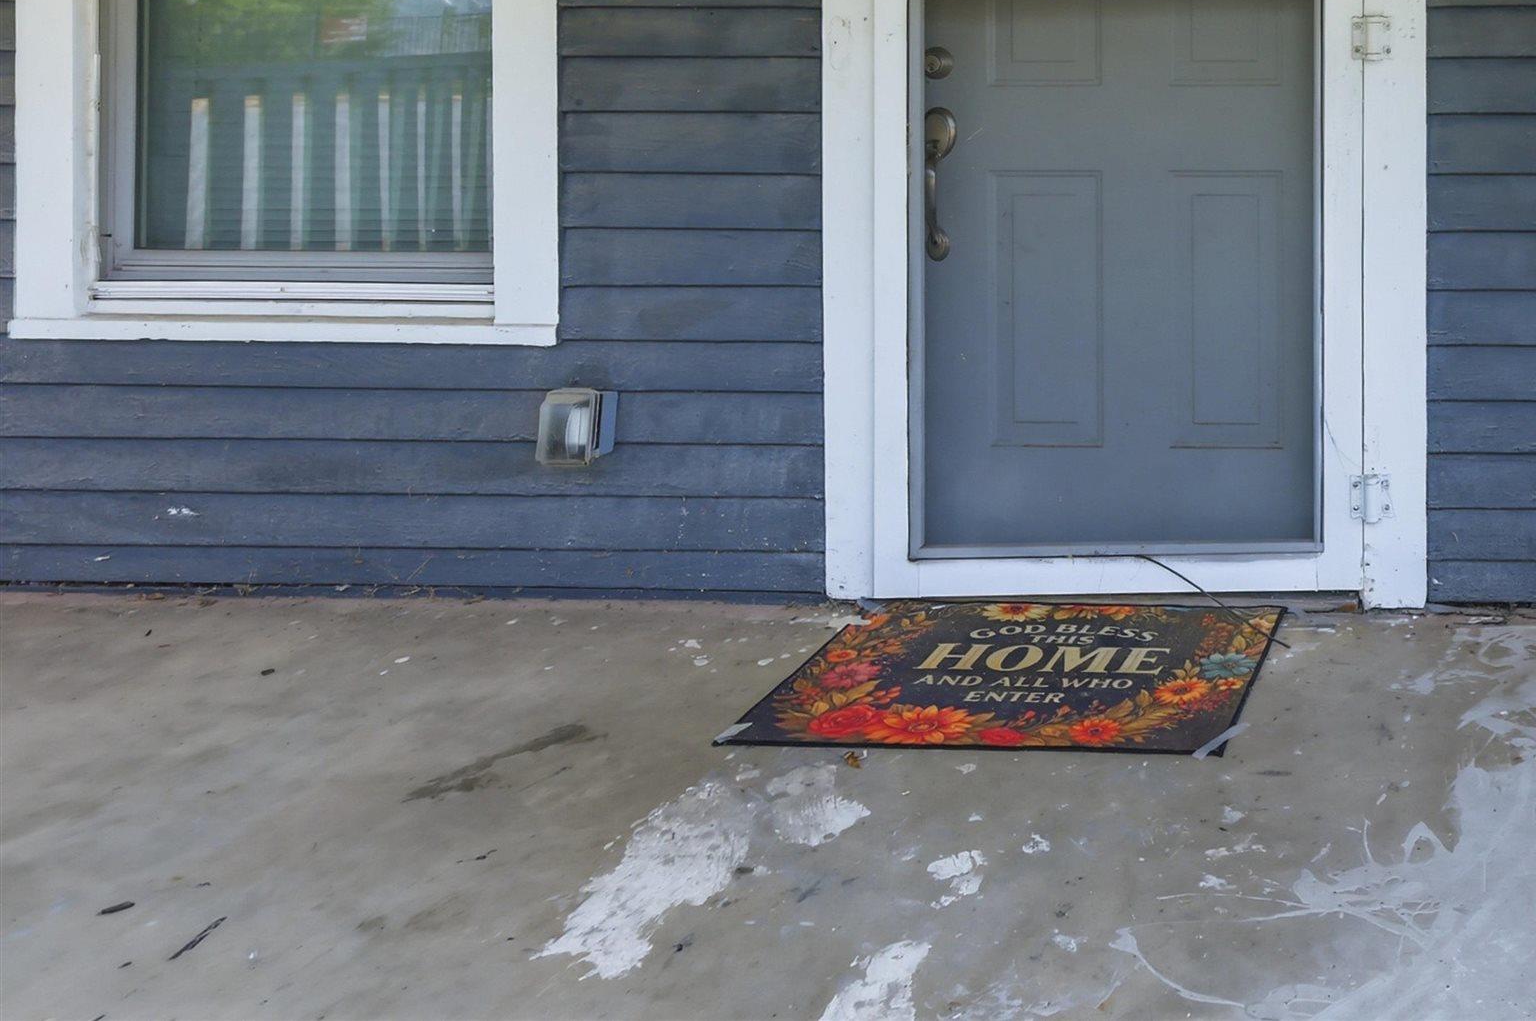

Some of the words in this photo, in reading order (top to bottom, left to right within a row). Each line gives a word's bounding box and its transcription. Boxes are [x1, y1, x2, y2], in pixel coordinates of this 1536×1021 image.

[969, 624, 1047, 640] GOD
[1055, 624, 1159, 643] BLESS
[1030, 634, 1096, 646] THIS
[912, 642, 1171, 676] HOME
[912, 674, 984, 686] AND
[991, 676, 1050, 688] ALL
[1061, 678, 1134, 689] WHO
[963, 690, 1066, 704] ENTER
